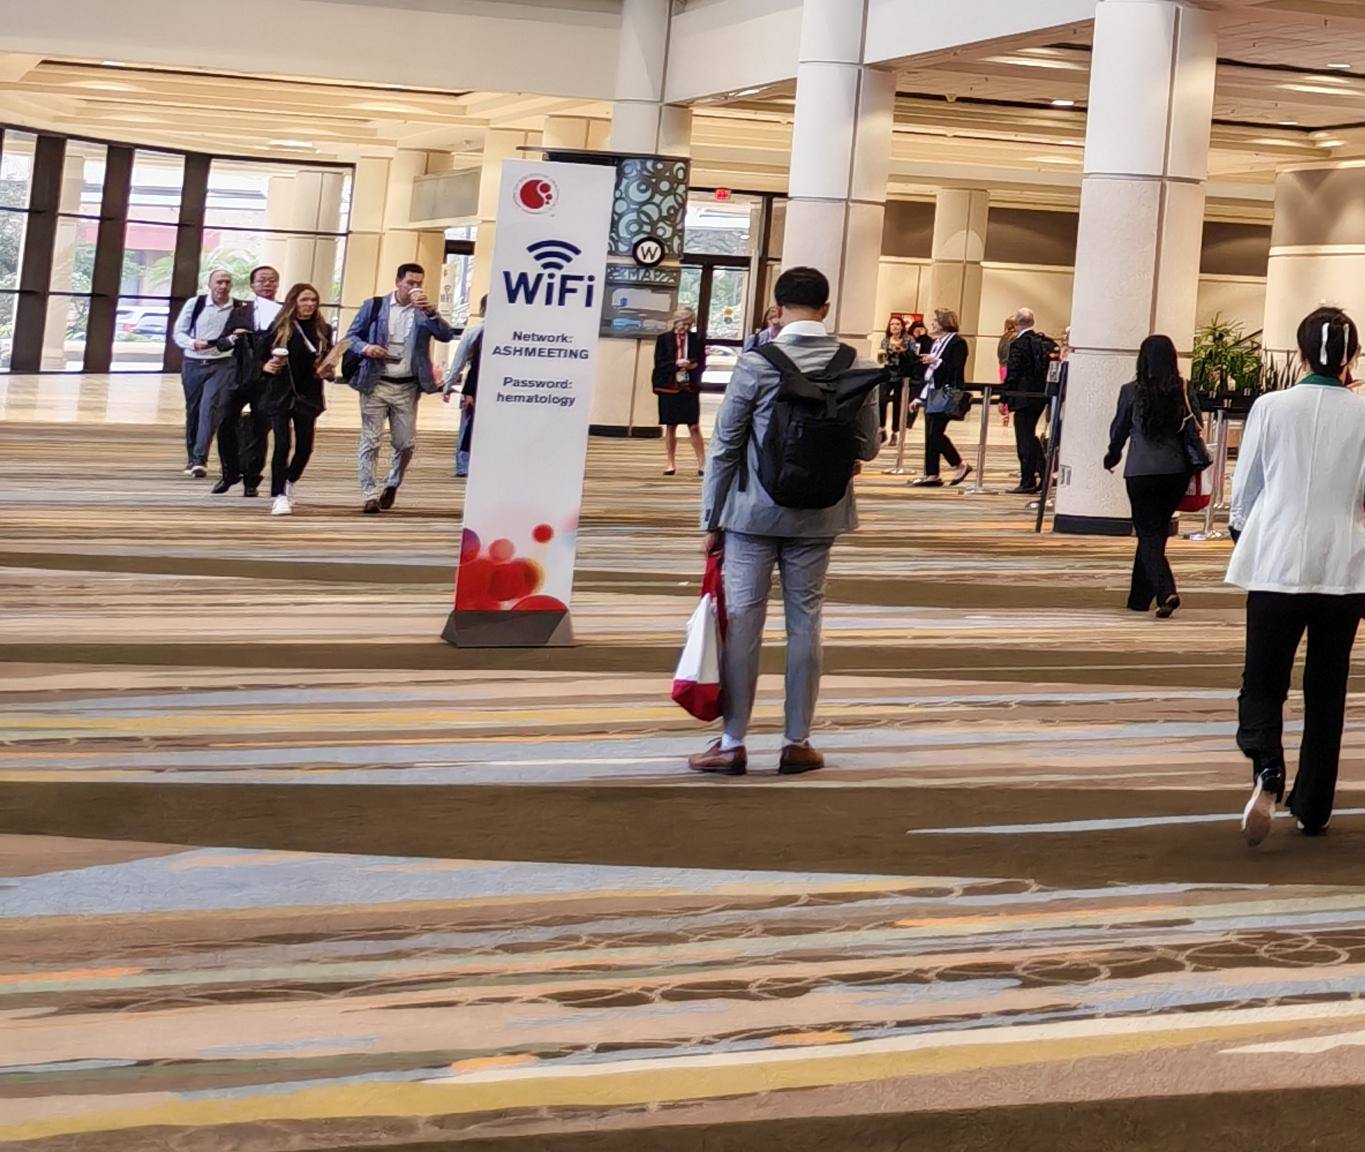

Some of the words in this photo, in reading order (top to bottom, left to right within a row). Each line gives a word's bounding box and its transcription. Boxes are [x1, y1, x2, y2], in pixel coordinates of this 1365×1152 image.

[640, 246, 659, 260] W
[503, 270, 596, 308] WiFi
[512, 331, 574, 344] Network:
[492, 345, 590, 359] ASHMEETING
[503, 376, 574, 389] Password:
[496, 391, 576, 407] hematology
